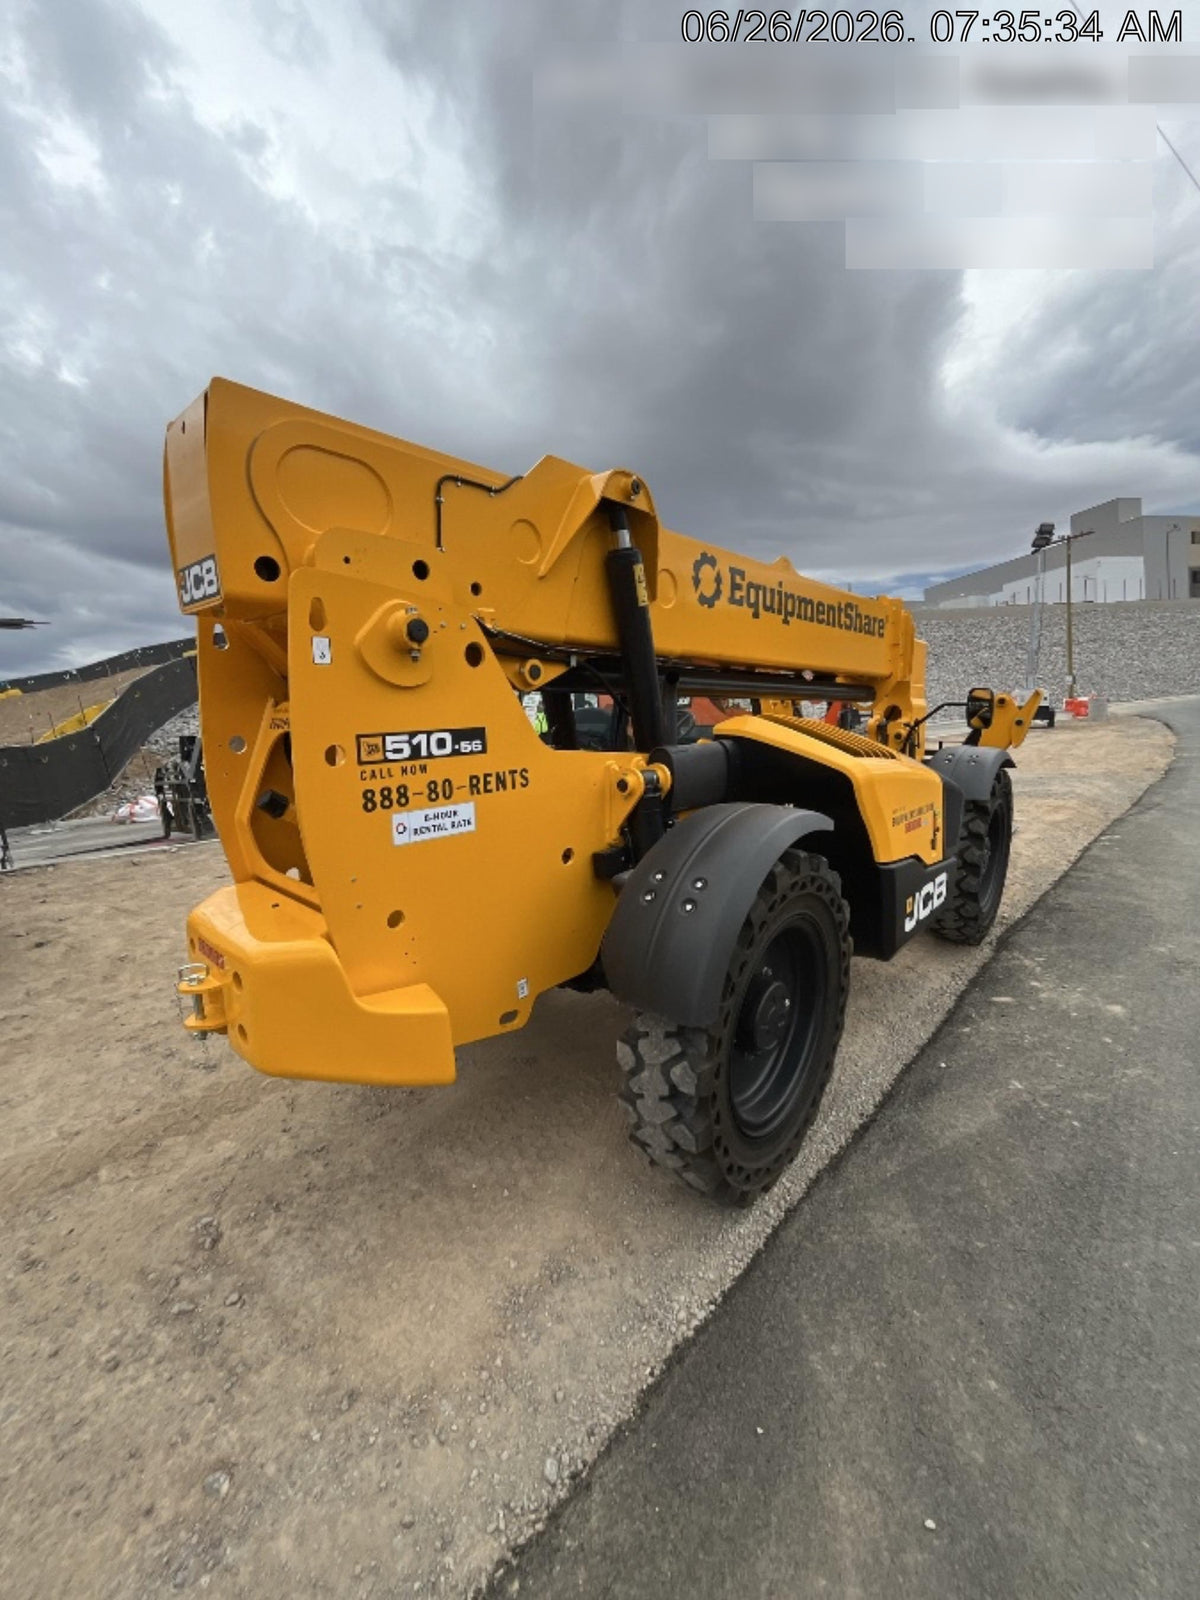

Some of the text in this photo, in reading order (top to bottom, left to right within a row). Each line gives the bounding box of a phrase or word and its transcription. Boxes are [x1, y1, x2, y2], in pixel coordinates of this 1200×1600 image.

[181, 559, 218, 604] JCB
[728, 566, 885, 638] EquipmentShare
[360, 764, 428, 781] CALL NOW
[362, 767, 530, 813] 888-80-RENTS
[904, 871, 948, 933] JCB
